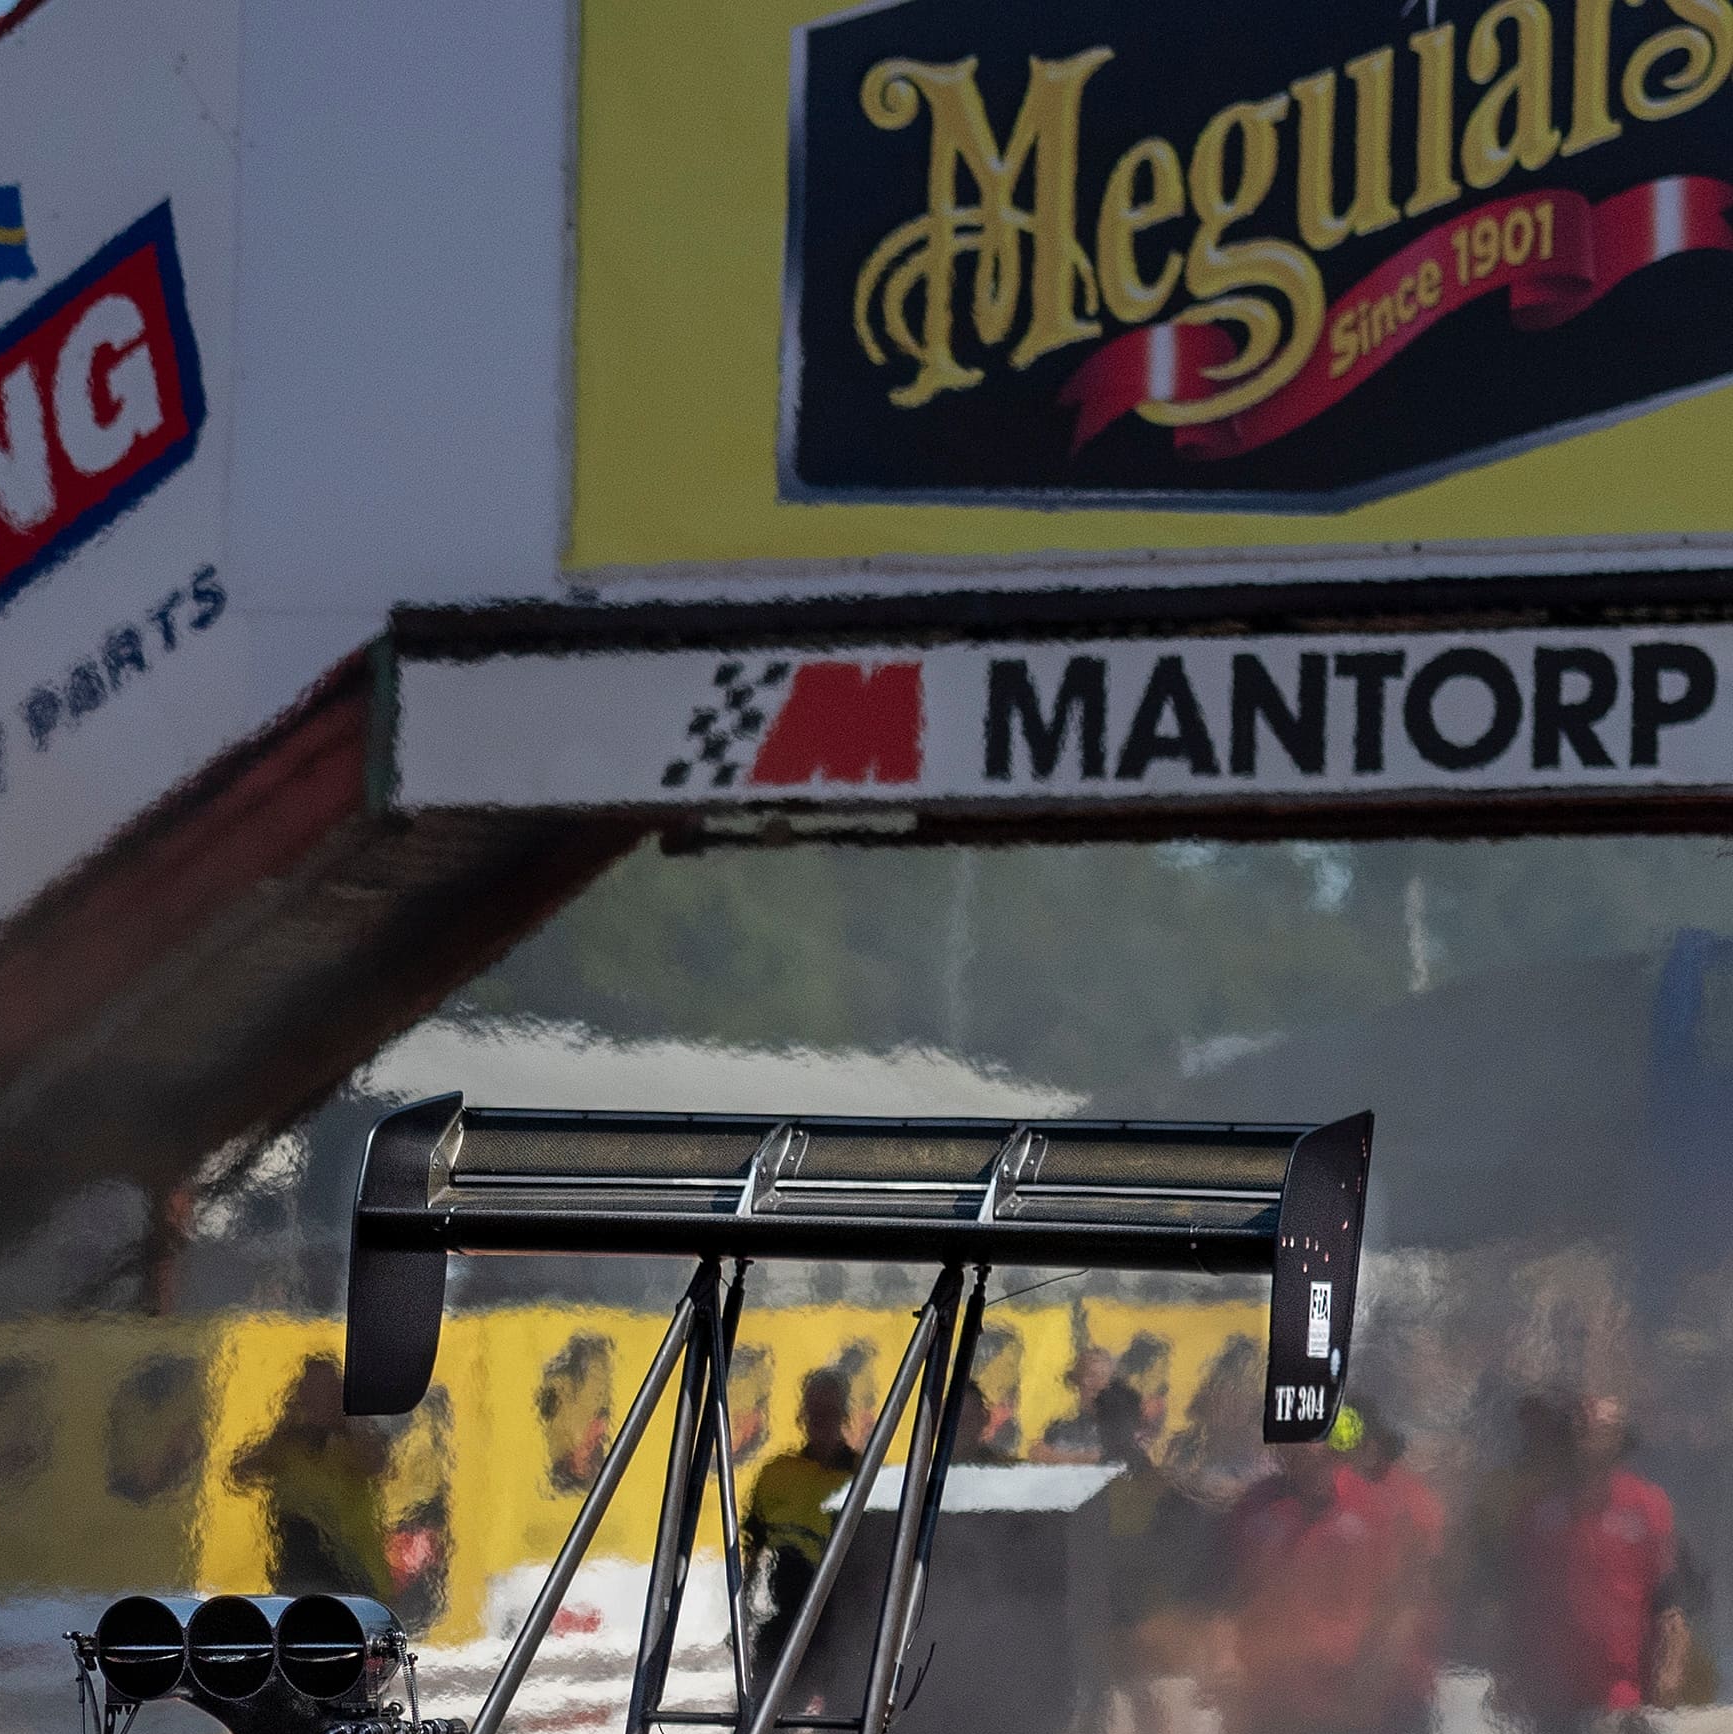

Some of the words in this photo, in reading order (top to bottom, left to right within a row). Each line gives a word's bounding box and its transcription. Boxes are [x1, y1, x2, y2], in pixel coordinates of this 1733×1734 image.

[1328, 260, 1441, 379] Since
[1451, 202, 1555, 286] 1901
[21, 564, 227, 753] PARTS
[981, 643, 1717, 782] MANTORP
[1275, 1385, 1296, 1422] TF
[1297, 1385, 1326, 1422] 304
